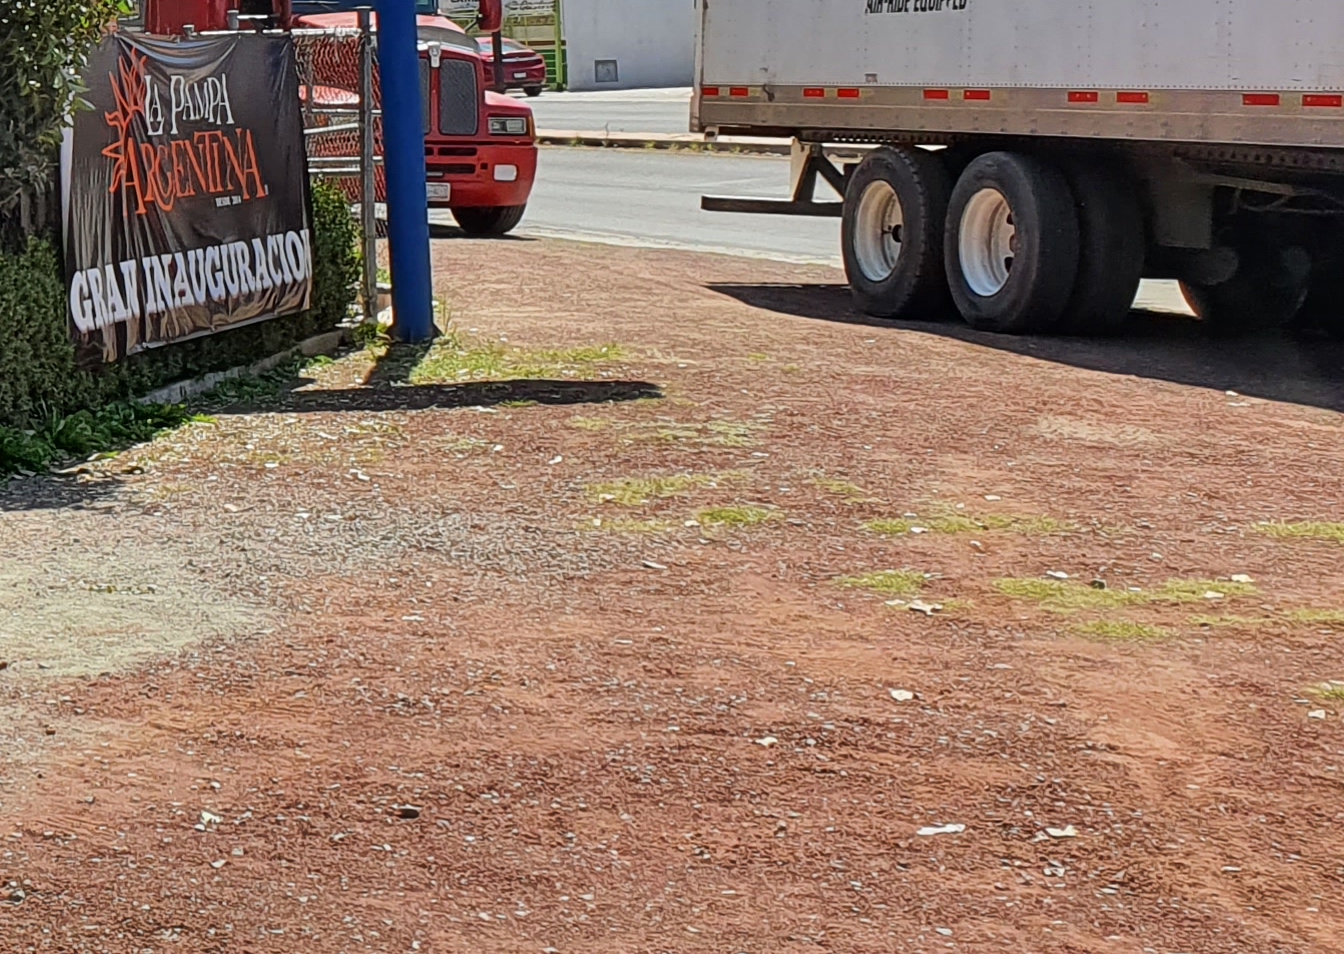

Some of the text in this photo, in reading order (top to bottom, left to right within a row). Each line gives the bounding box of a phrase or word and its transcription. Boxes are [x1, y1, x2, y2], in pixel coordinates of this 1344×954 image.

[170, 72, 234, 135] PAMPA
[122, 127, 267, 215] ARGENTINA
[70, 259, 141, 333] GRAN
